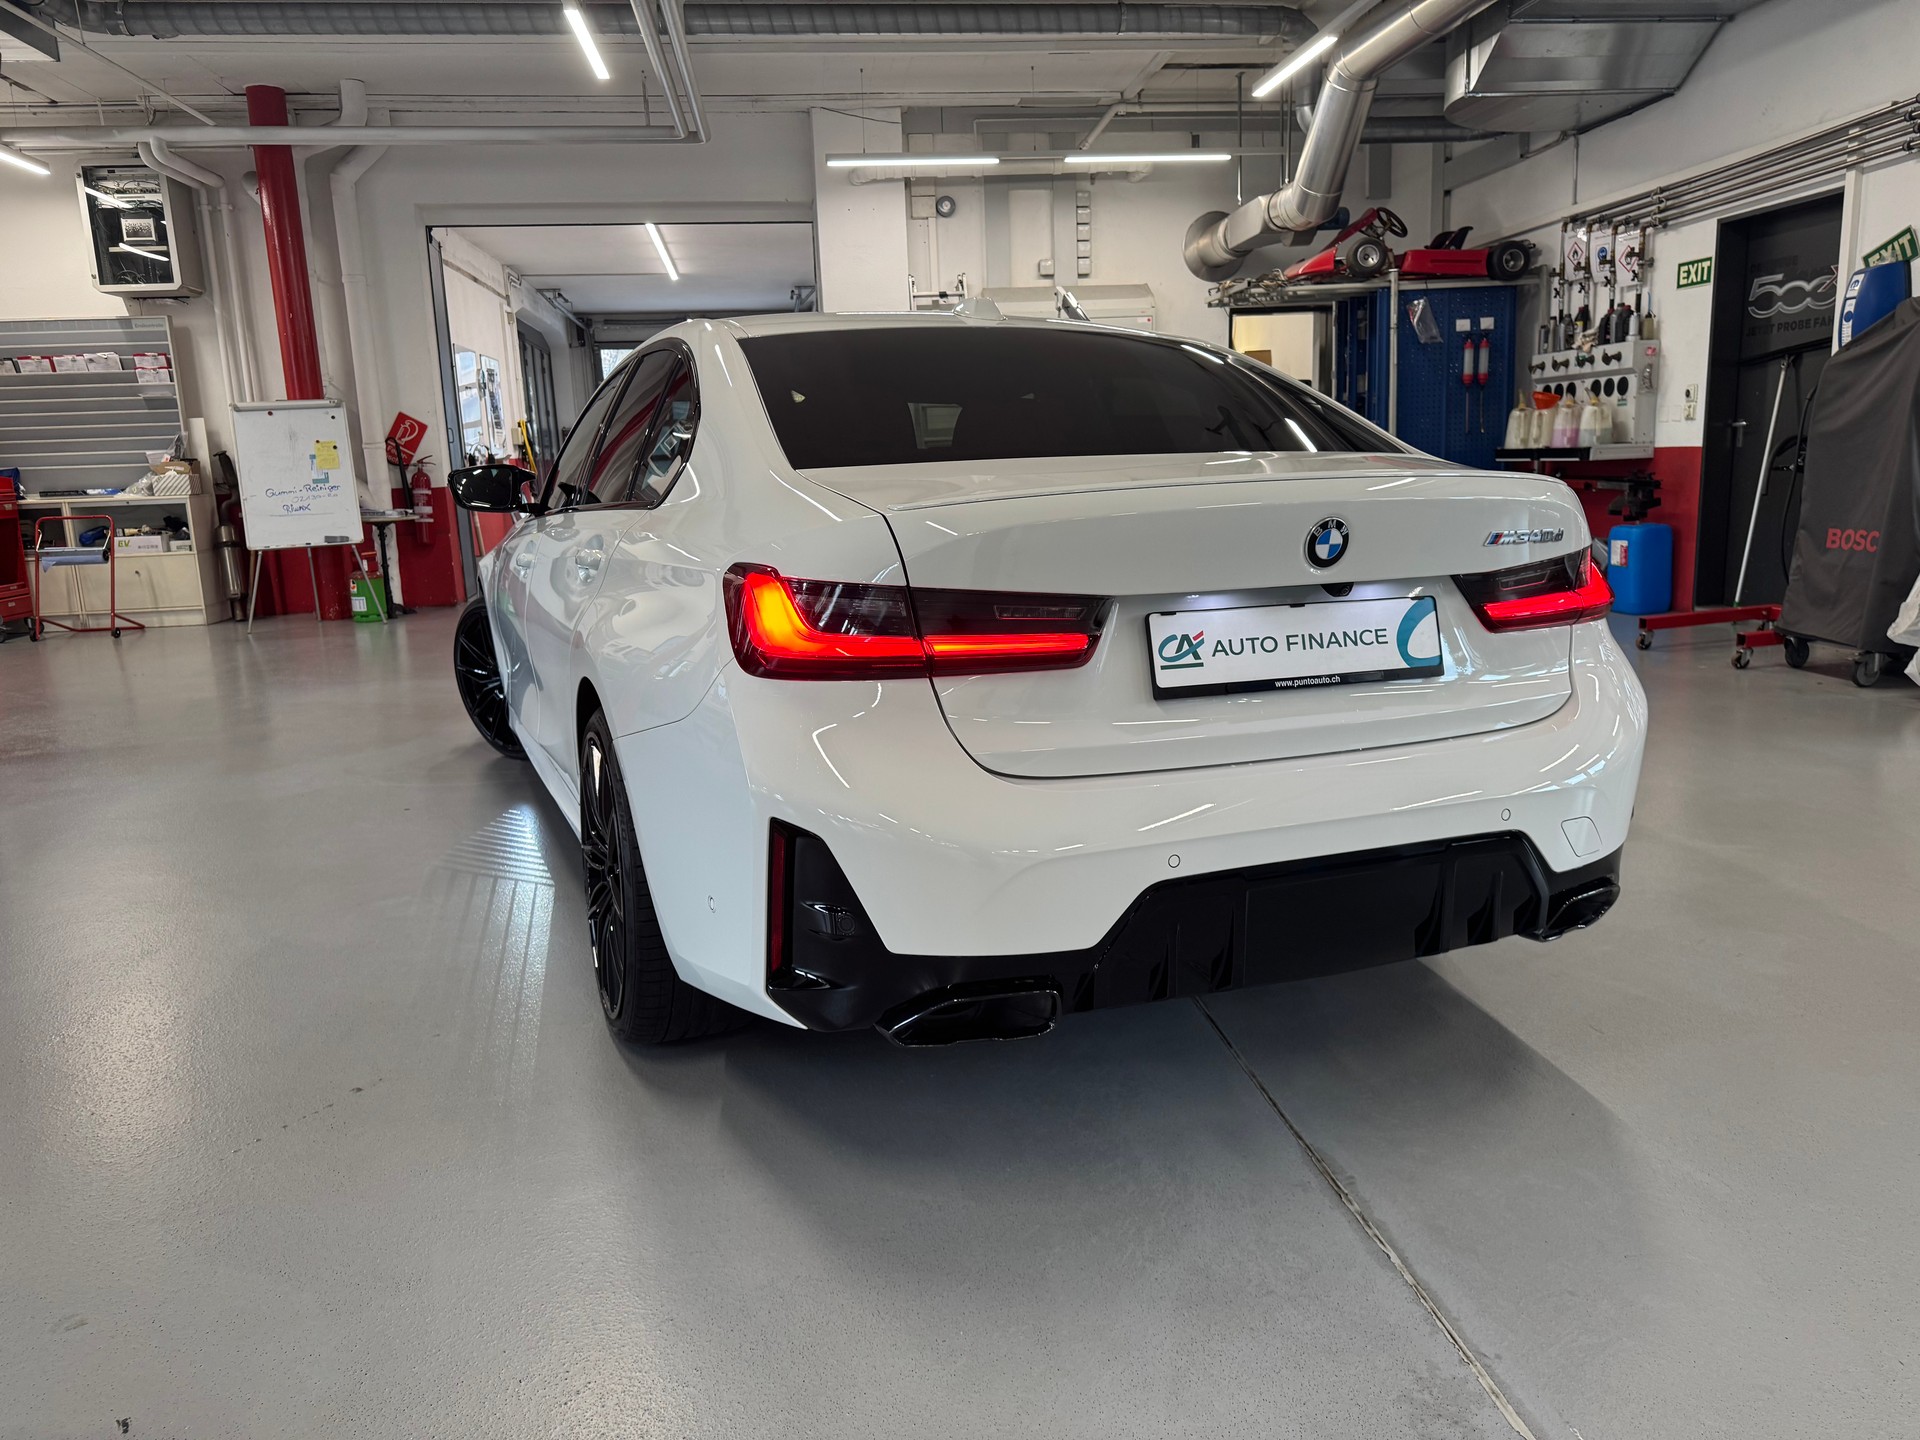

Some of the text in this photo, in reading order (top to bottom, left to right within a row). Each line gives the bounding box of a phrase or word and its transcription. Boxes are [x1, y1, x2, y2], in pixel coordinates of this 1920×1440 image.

[1867, 232, 1913, 265] EXIT
[1679, 260, 1711, 285] EXIT
[1776, 317, 1812, 333] PROBE
[1313, 519, 1349, 537] BMW
[1211, 635, 1278, 658] AUTO
[1285, 627, 1389, 652] FINANCE
[1274, 675, 1342, 689] www.puntoauto.ch
